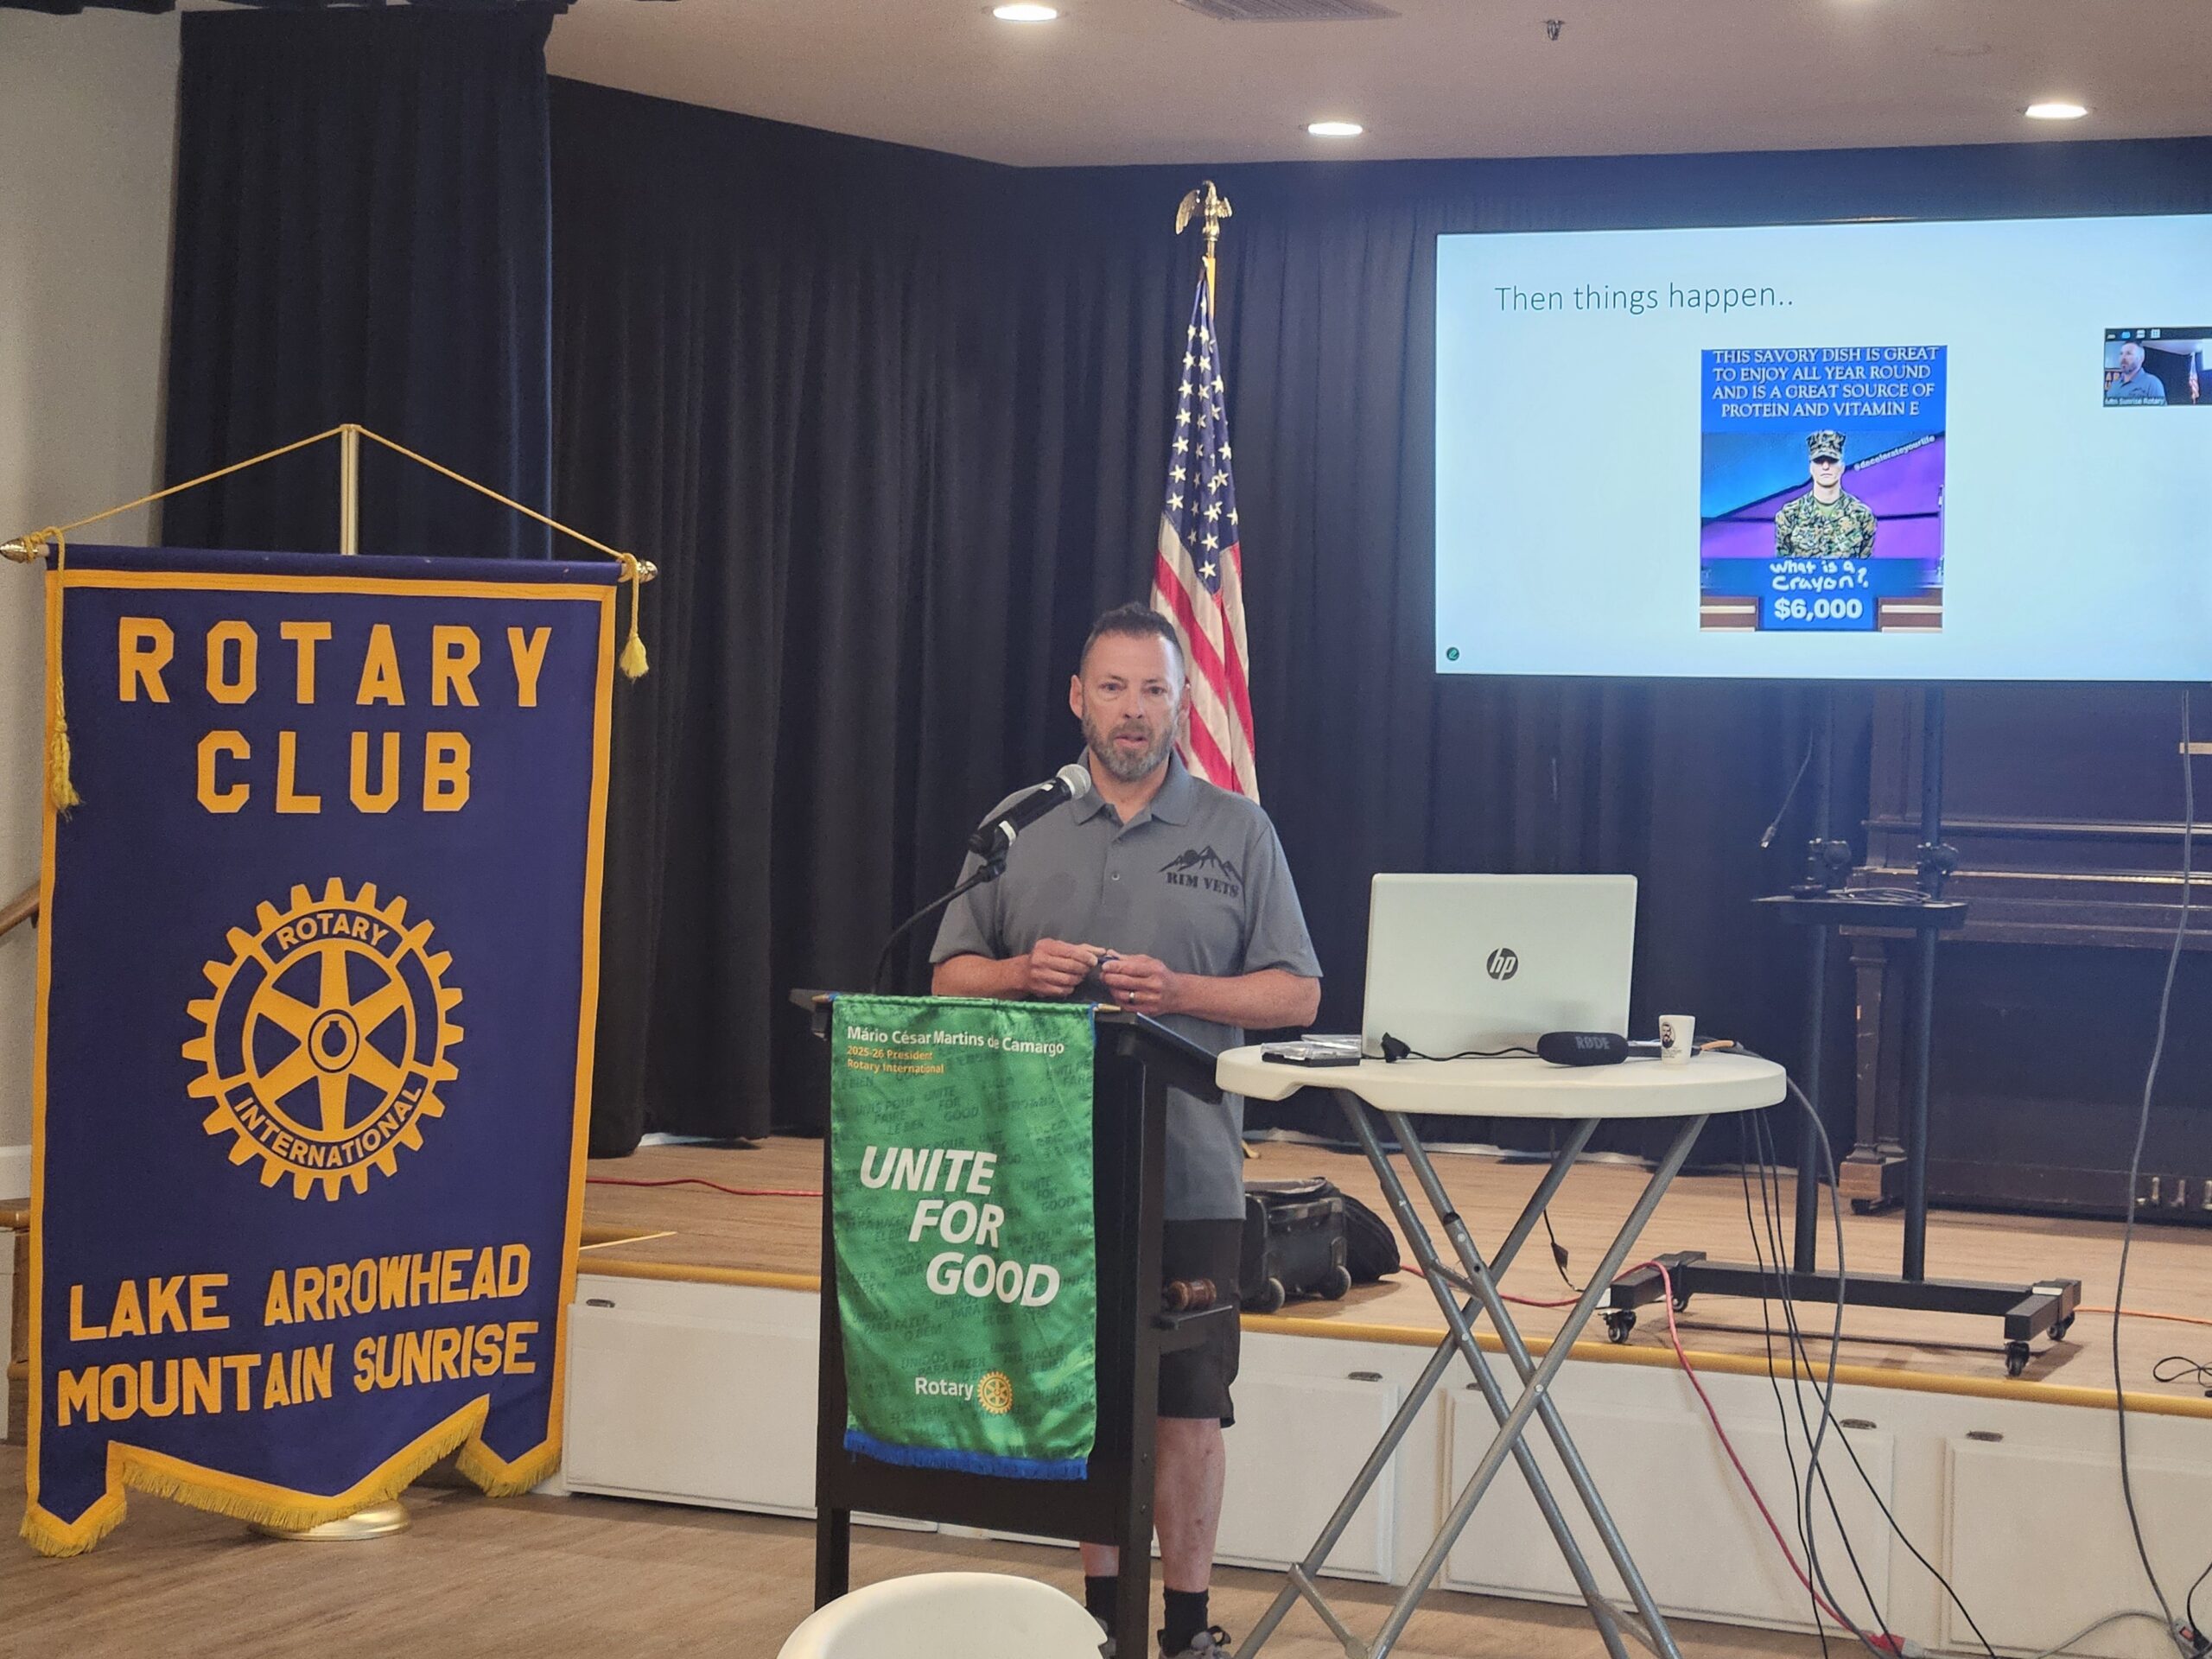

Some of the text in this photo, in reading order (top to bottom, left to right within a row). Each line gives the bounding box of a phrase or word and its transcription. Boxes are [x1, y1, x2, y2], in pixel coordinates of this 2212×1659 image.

[1494, 283, 1793, 315] Then things happen..
[1713, 346, 1939, 364] THIS SAVORY DISH IS GREAT
[1713, 365, 1931, 384] TO ENJOY ALL YEAR ROUND
[1713, 383, 1935, 399] AND IS A GREAT SOURCE OF
[1721, 401, 1920, 417] PROTEIN AND VITAMIN E
[1821, 560, 1838, 574] is
[1843, 560, 1855, 574] a
[1774, 596, 1863, 622] $6,000
[118, 616, 552, 707] ROTARY
[196, 730, 472, 813] CLUB
[1166, 872, 1239, 898] RIM VETS
[276, 913, 389, 950] ROTARY
[1488, 948, 1517, 980] hp
[847, 1026, 1065, 1058] Mário César Martins de Camargo
[847, 1046, 932, 1060] 2025-26 President
[847, 1058, 880, 1074] Rotary
[883, 1063, 944, 1074] International
[233, 1088, 422, 1167] INTERNATIONAL
[860, 1145, 997, 1195] UNITE
[908, 1198, 1005, 1249] FOR
[70, 1243, 531, 1341] LAKE ARROWHEAD
[926, 1252, 1060, 1307] GOOD
[57, 1321, 539, 1427] MOUNTAIN SUNRISE
[915, 1377, 974, 1401] Rotary
